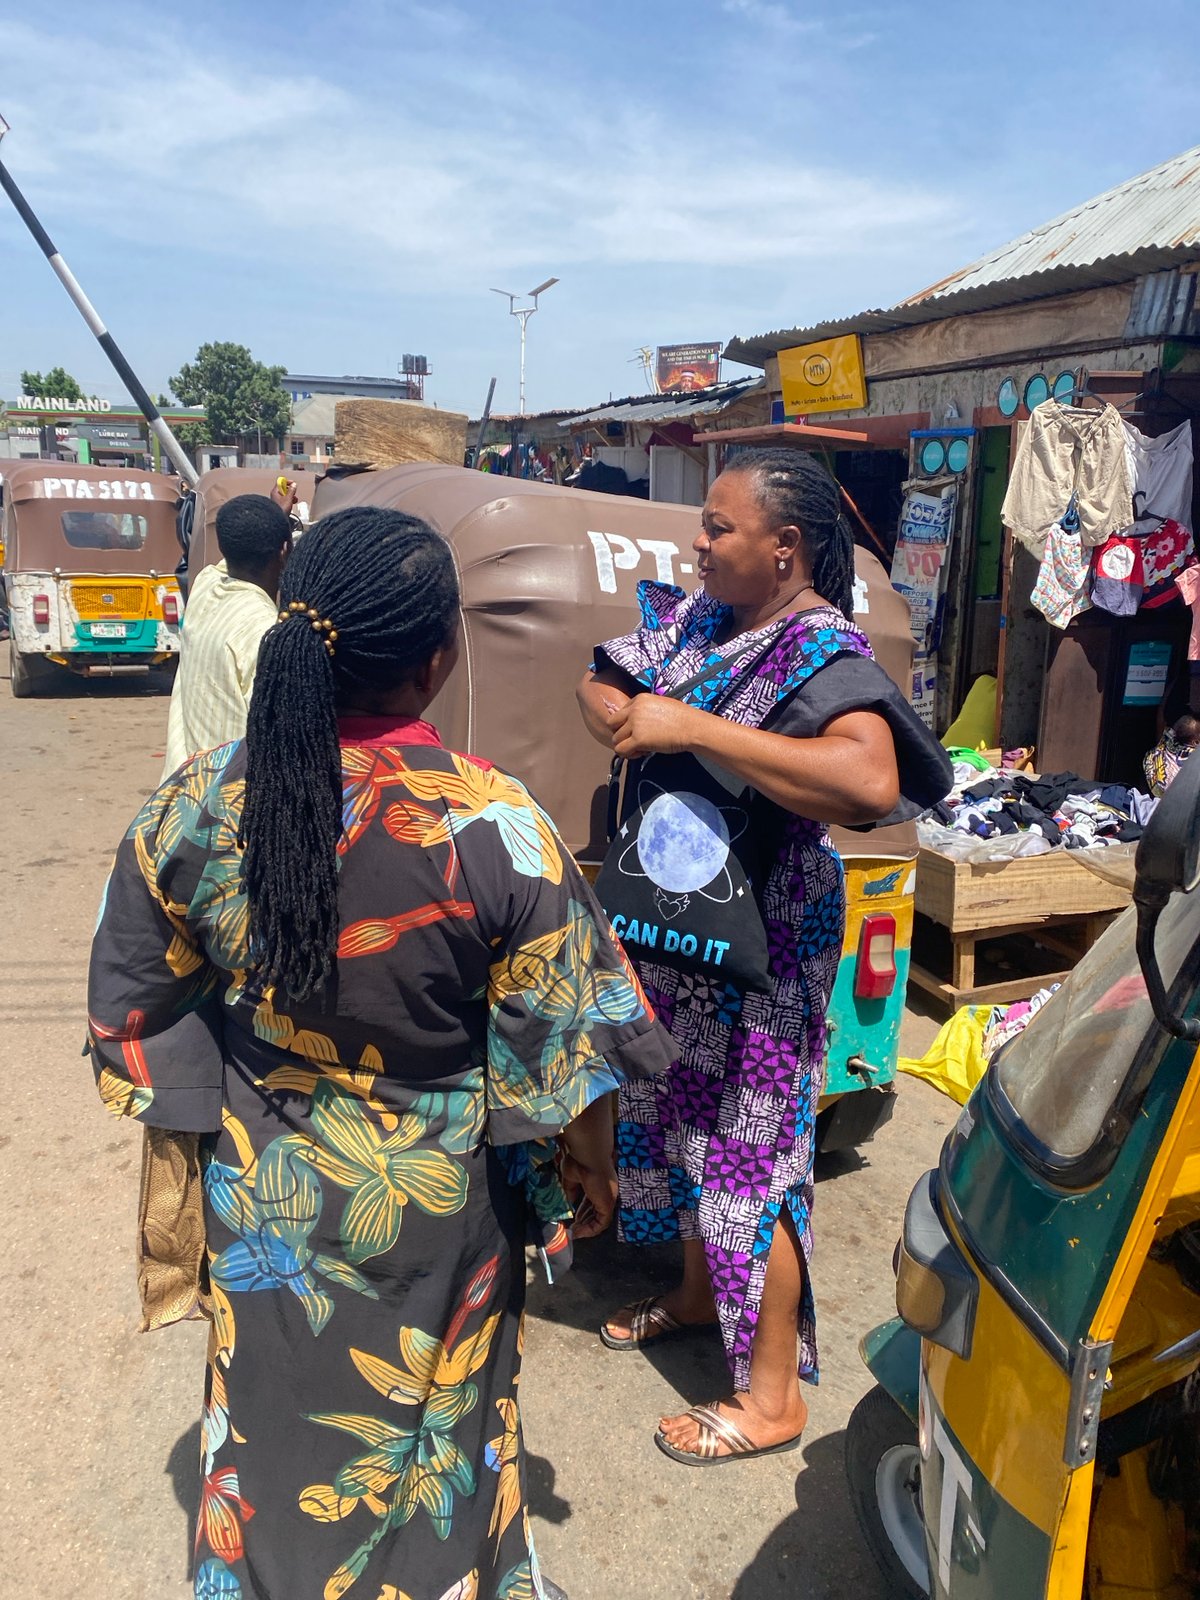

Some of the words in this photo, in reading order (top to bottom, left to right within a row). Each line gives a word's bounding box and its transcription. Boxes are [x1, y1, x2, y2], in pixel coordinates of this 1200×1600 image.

[809, 363, 825, 377] MTN
[17, 396, 111, 412] MAINLAND
[611, 914, 658, 948] CAN
[663, 929, 698, 957] DO
[702, 938, 730, 966] IT
